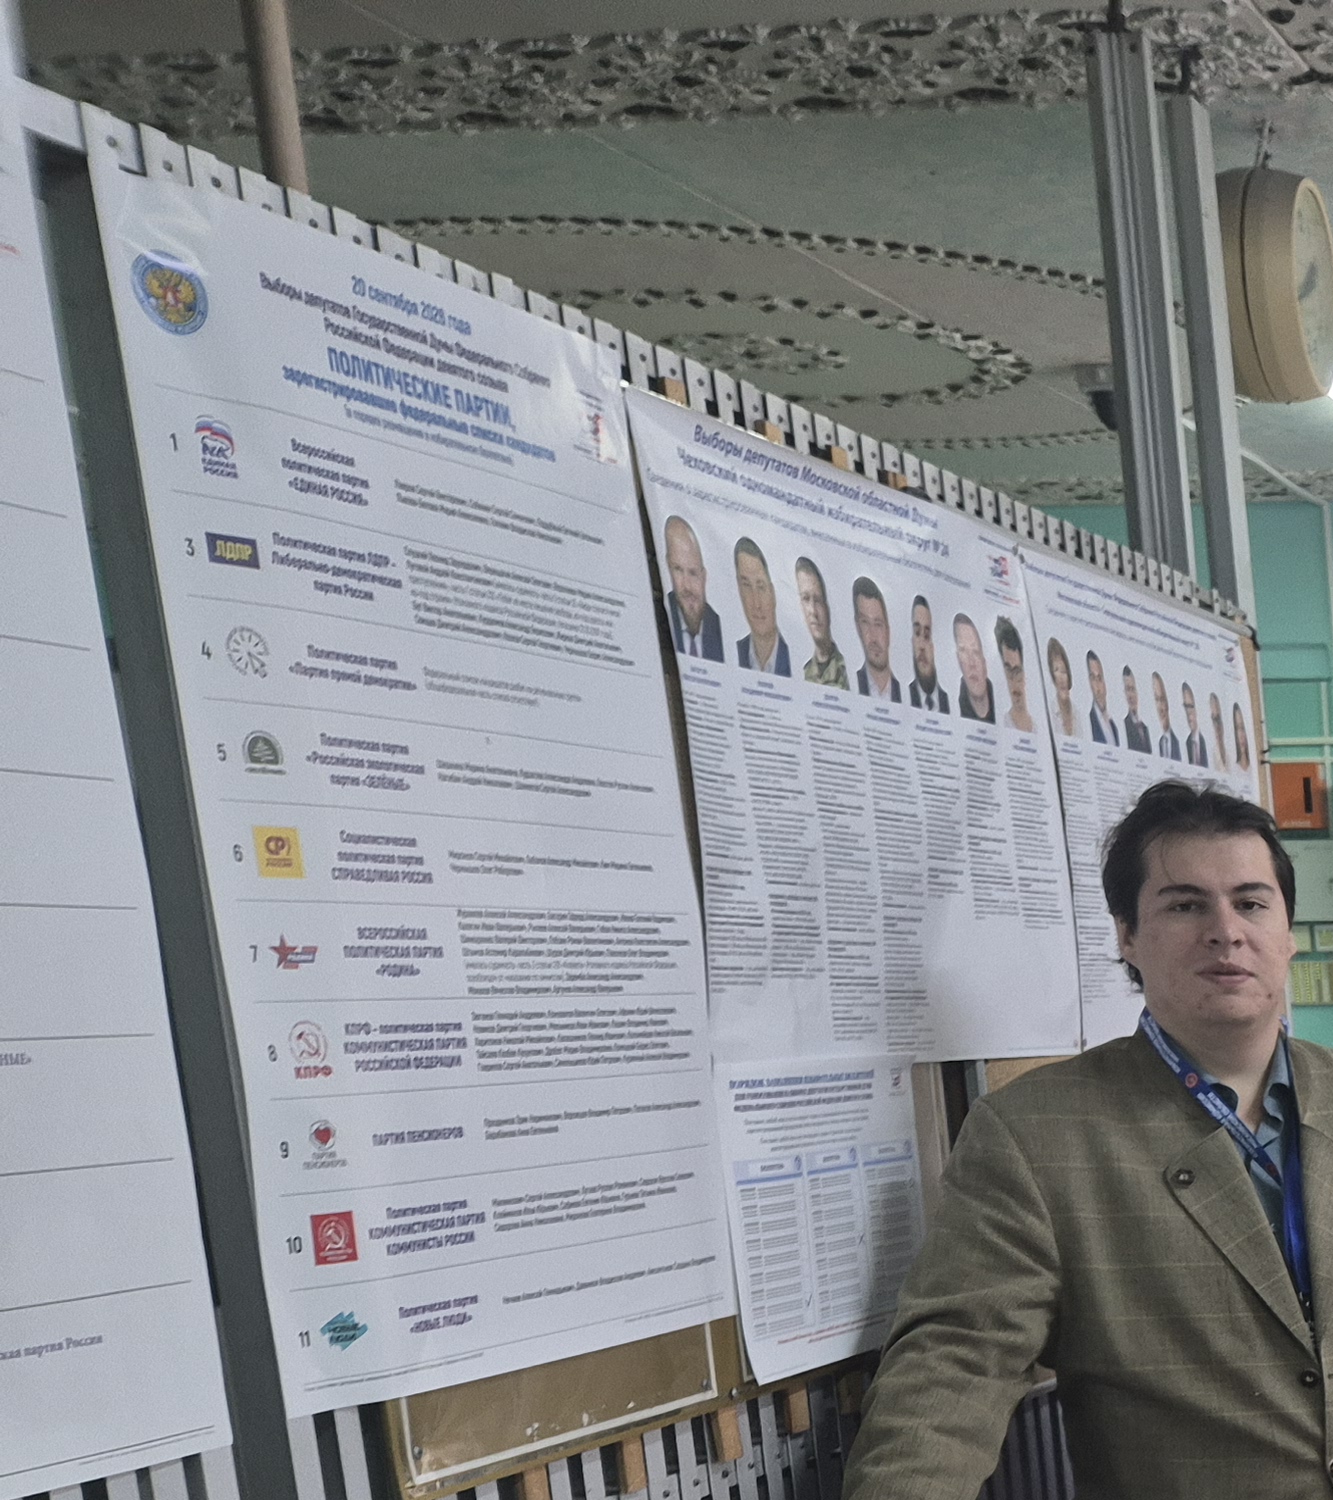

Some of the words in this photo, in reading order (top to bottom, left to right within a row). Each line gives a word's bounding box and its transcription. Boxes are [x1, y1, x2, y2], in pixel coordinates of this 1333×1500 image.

[326, 346, 452, 409] ПОЛИТИЧЕСКИЕ
[169, 432, 178, 451] 1
[693, 423, 743, 458] Выборы
[743, 447, 801, 480] депутатов
[184, 537, 195, 557] 3
[201, 641, 212, 660] 4
[216, 743, 227, 762] 5
[233, 844, 243, 862] 6
[249, 945, 258, 963] 7
[267, 1044, 278, 1062] 8
[294, 1065, 333, 1079] КПРФ
[279, 1141, 289, 1159] 9
[286, 1236, 302, 1254] 10
[299, 1330, 311, 1348] 11
